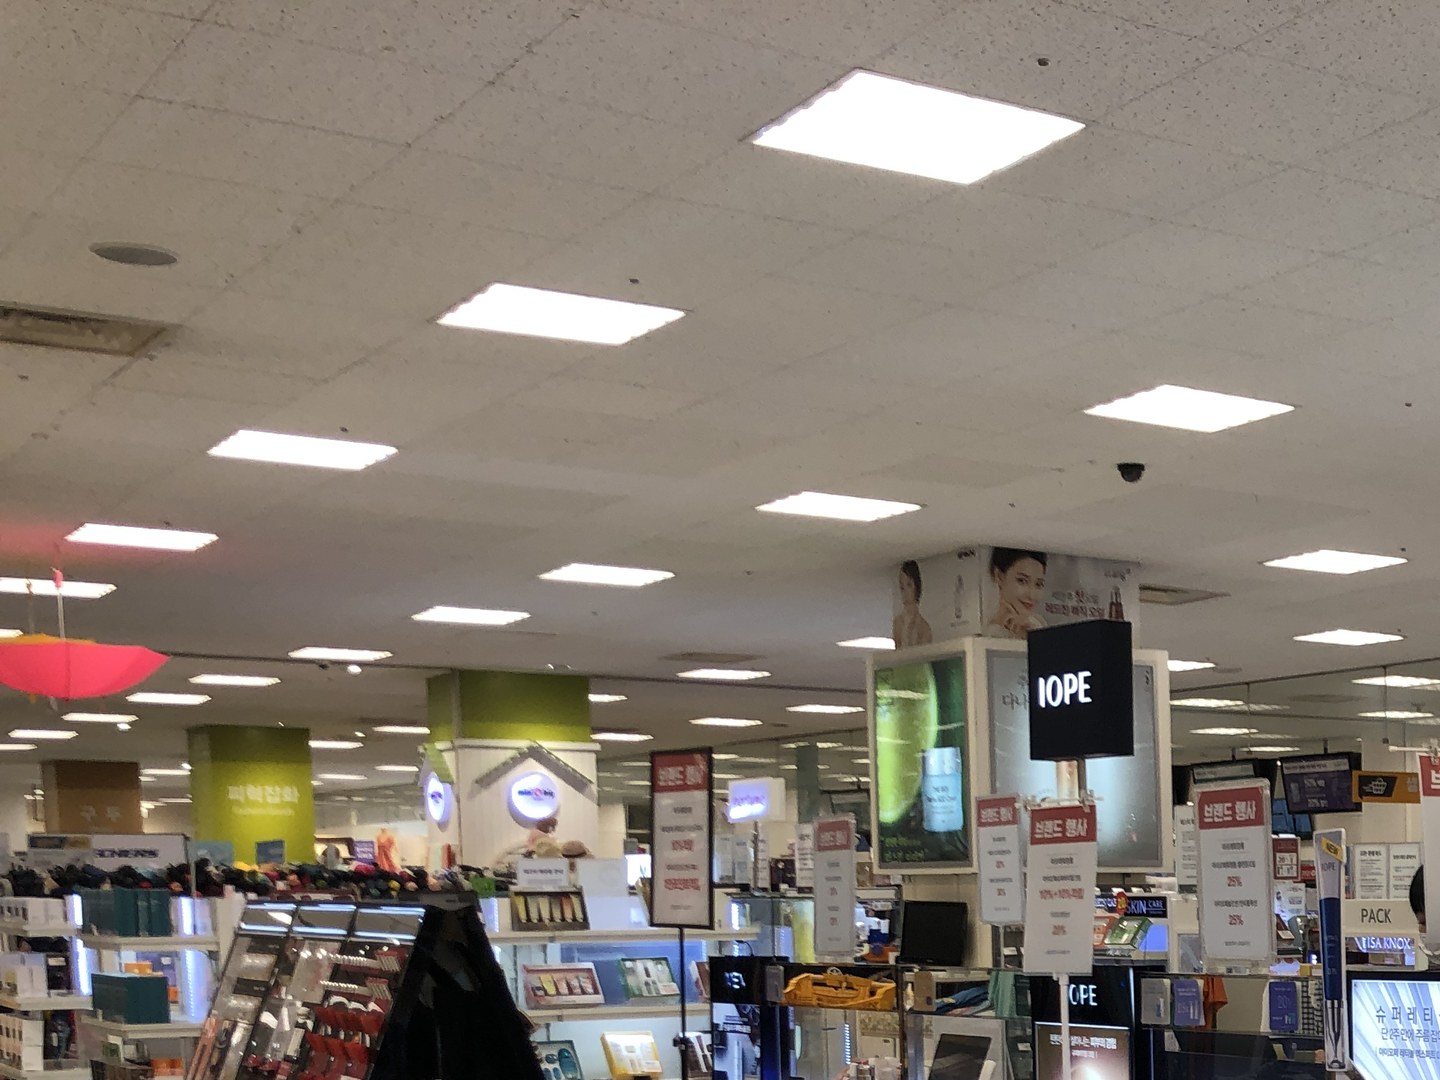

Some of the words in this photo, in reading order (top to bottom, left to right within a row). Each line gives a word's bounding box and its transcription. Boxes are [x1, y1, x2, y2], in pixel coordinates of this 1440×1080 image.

[1038, 670, 1092, 709] IOPE
[1204, 803, 1232, 823] 브랜드
[1234, 800, 1257, 821] 행사
[1126, 900, 1147, 914] SKIN
[1360, 908, 1392, 925] PACK
[1366, 936, 1383, 950] ISA
[1383, 936, 1412, 951] KNOX
[1068, 984, 1098, 1006] OPE
[1416, 1029, 1430, 1043] 주름
